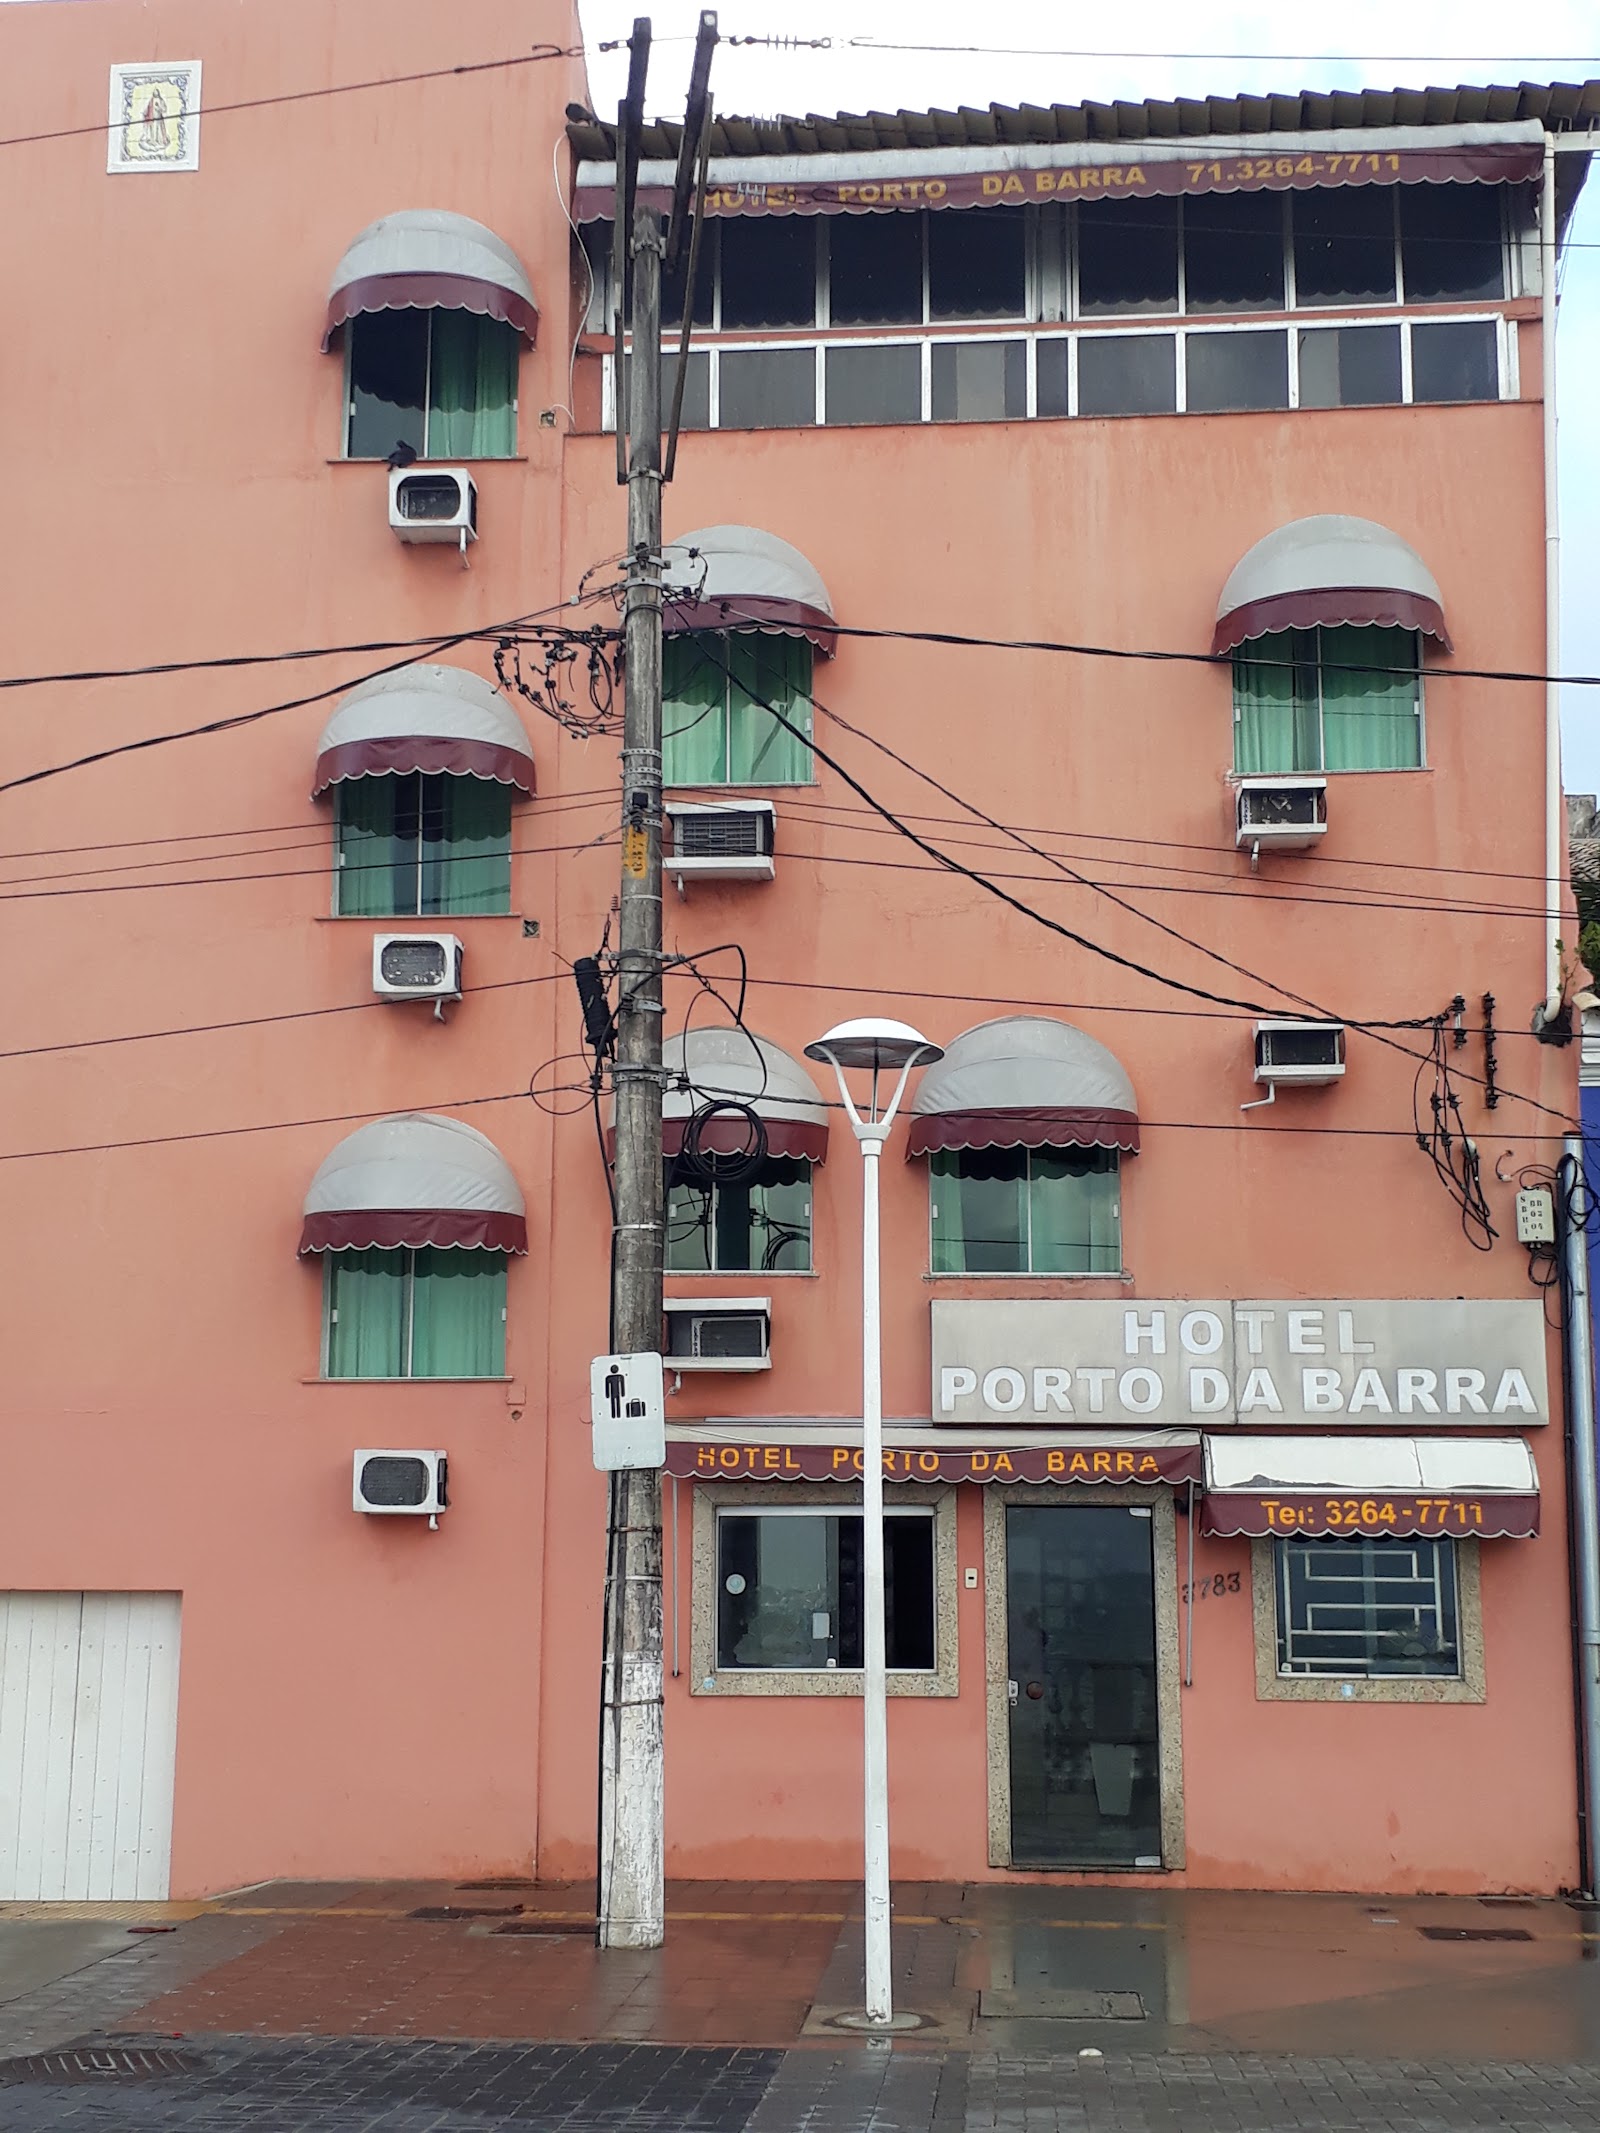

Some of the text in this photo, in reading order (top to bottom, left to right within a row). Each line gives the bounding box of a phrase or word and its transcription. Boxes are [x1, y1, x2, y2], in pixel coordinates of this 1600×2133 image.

[838, 180, 947, 203] PORTO
[982, 174, 1025, 195] DA
[1036, 166, 1147, 192] BARRA
[1186, 154, 1400, 184] 71.3264-7711
[1124, 1309, 1376, 1356] HOTEL
[940, 1366, 1540, 1415] PORTO DA BARRA
[697, 1447, 801, 1469] HOTEL
[971, 1449, 1014, 1472] DA
[1047, 1451, 1160, 1473] BARRA
[1325, 1499, 1483, 1525] 3264-7711
